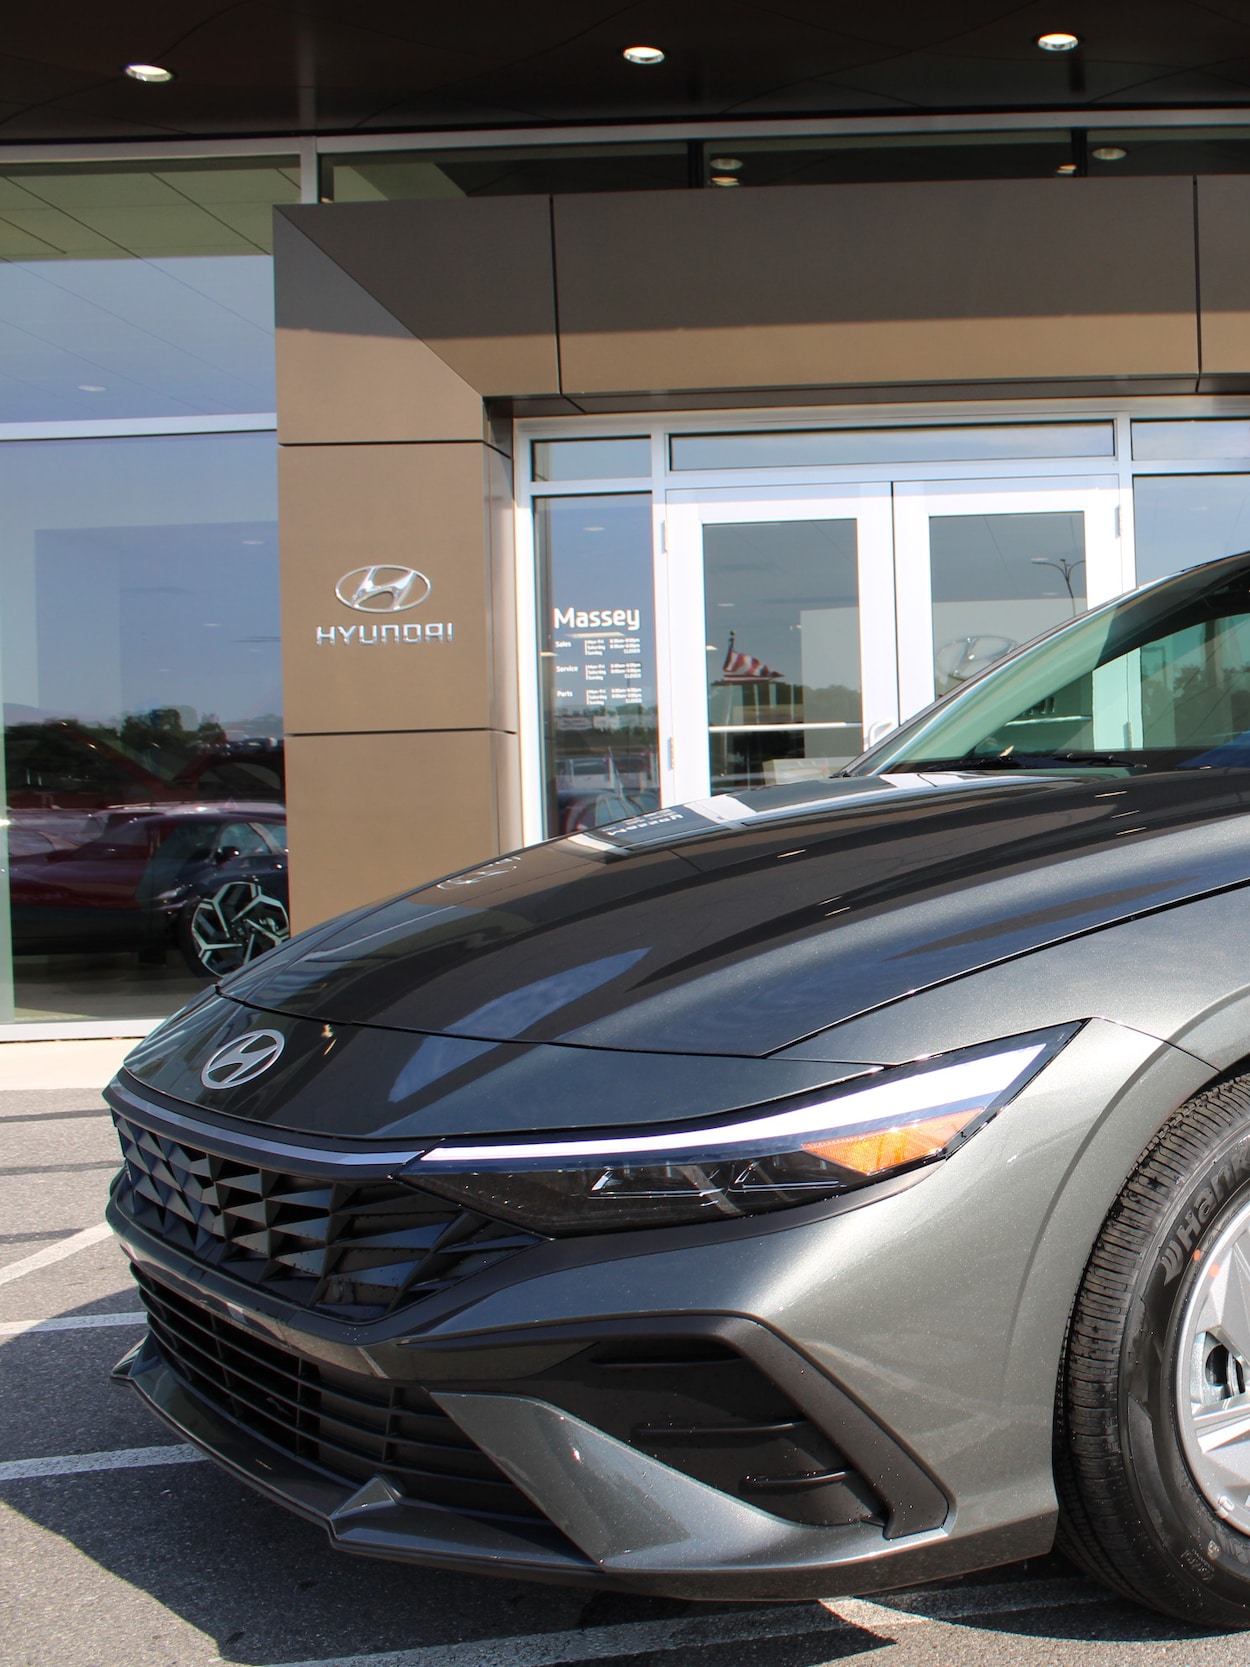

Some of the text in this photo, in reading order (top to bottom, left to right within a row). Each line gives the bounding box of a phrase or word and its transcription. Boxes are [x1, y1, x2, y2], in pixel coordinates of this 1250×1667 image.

[553, 607, 640, 631] Massey
[316, 622, 453, 645] HYUNDAI
[555, 640, 572, 648] Sales
[556, 665, 579, 673] Service
